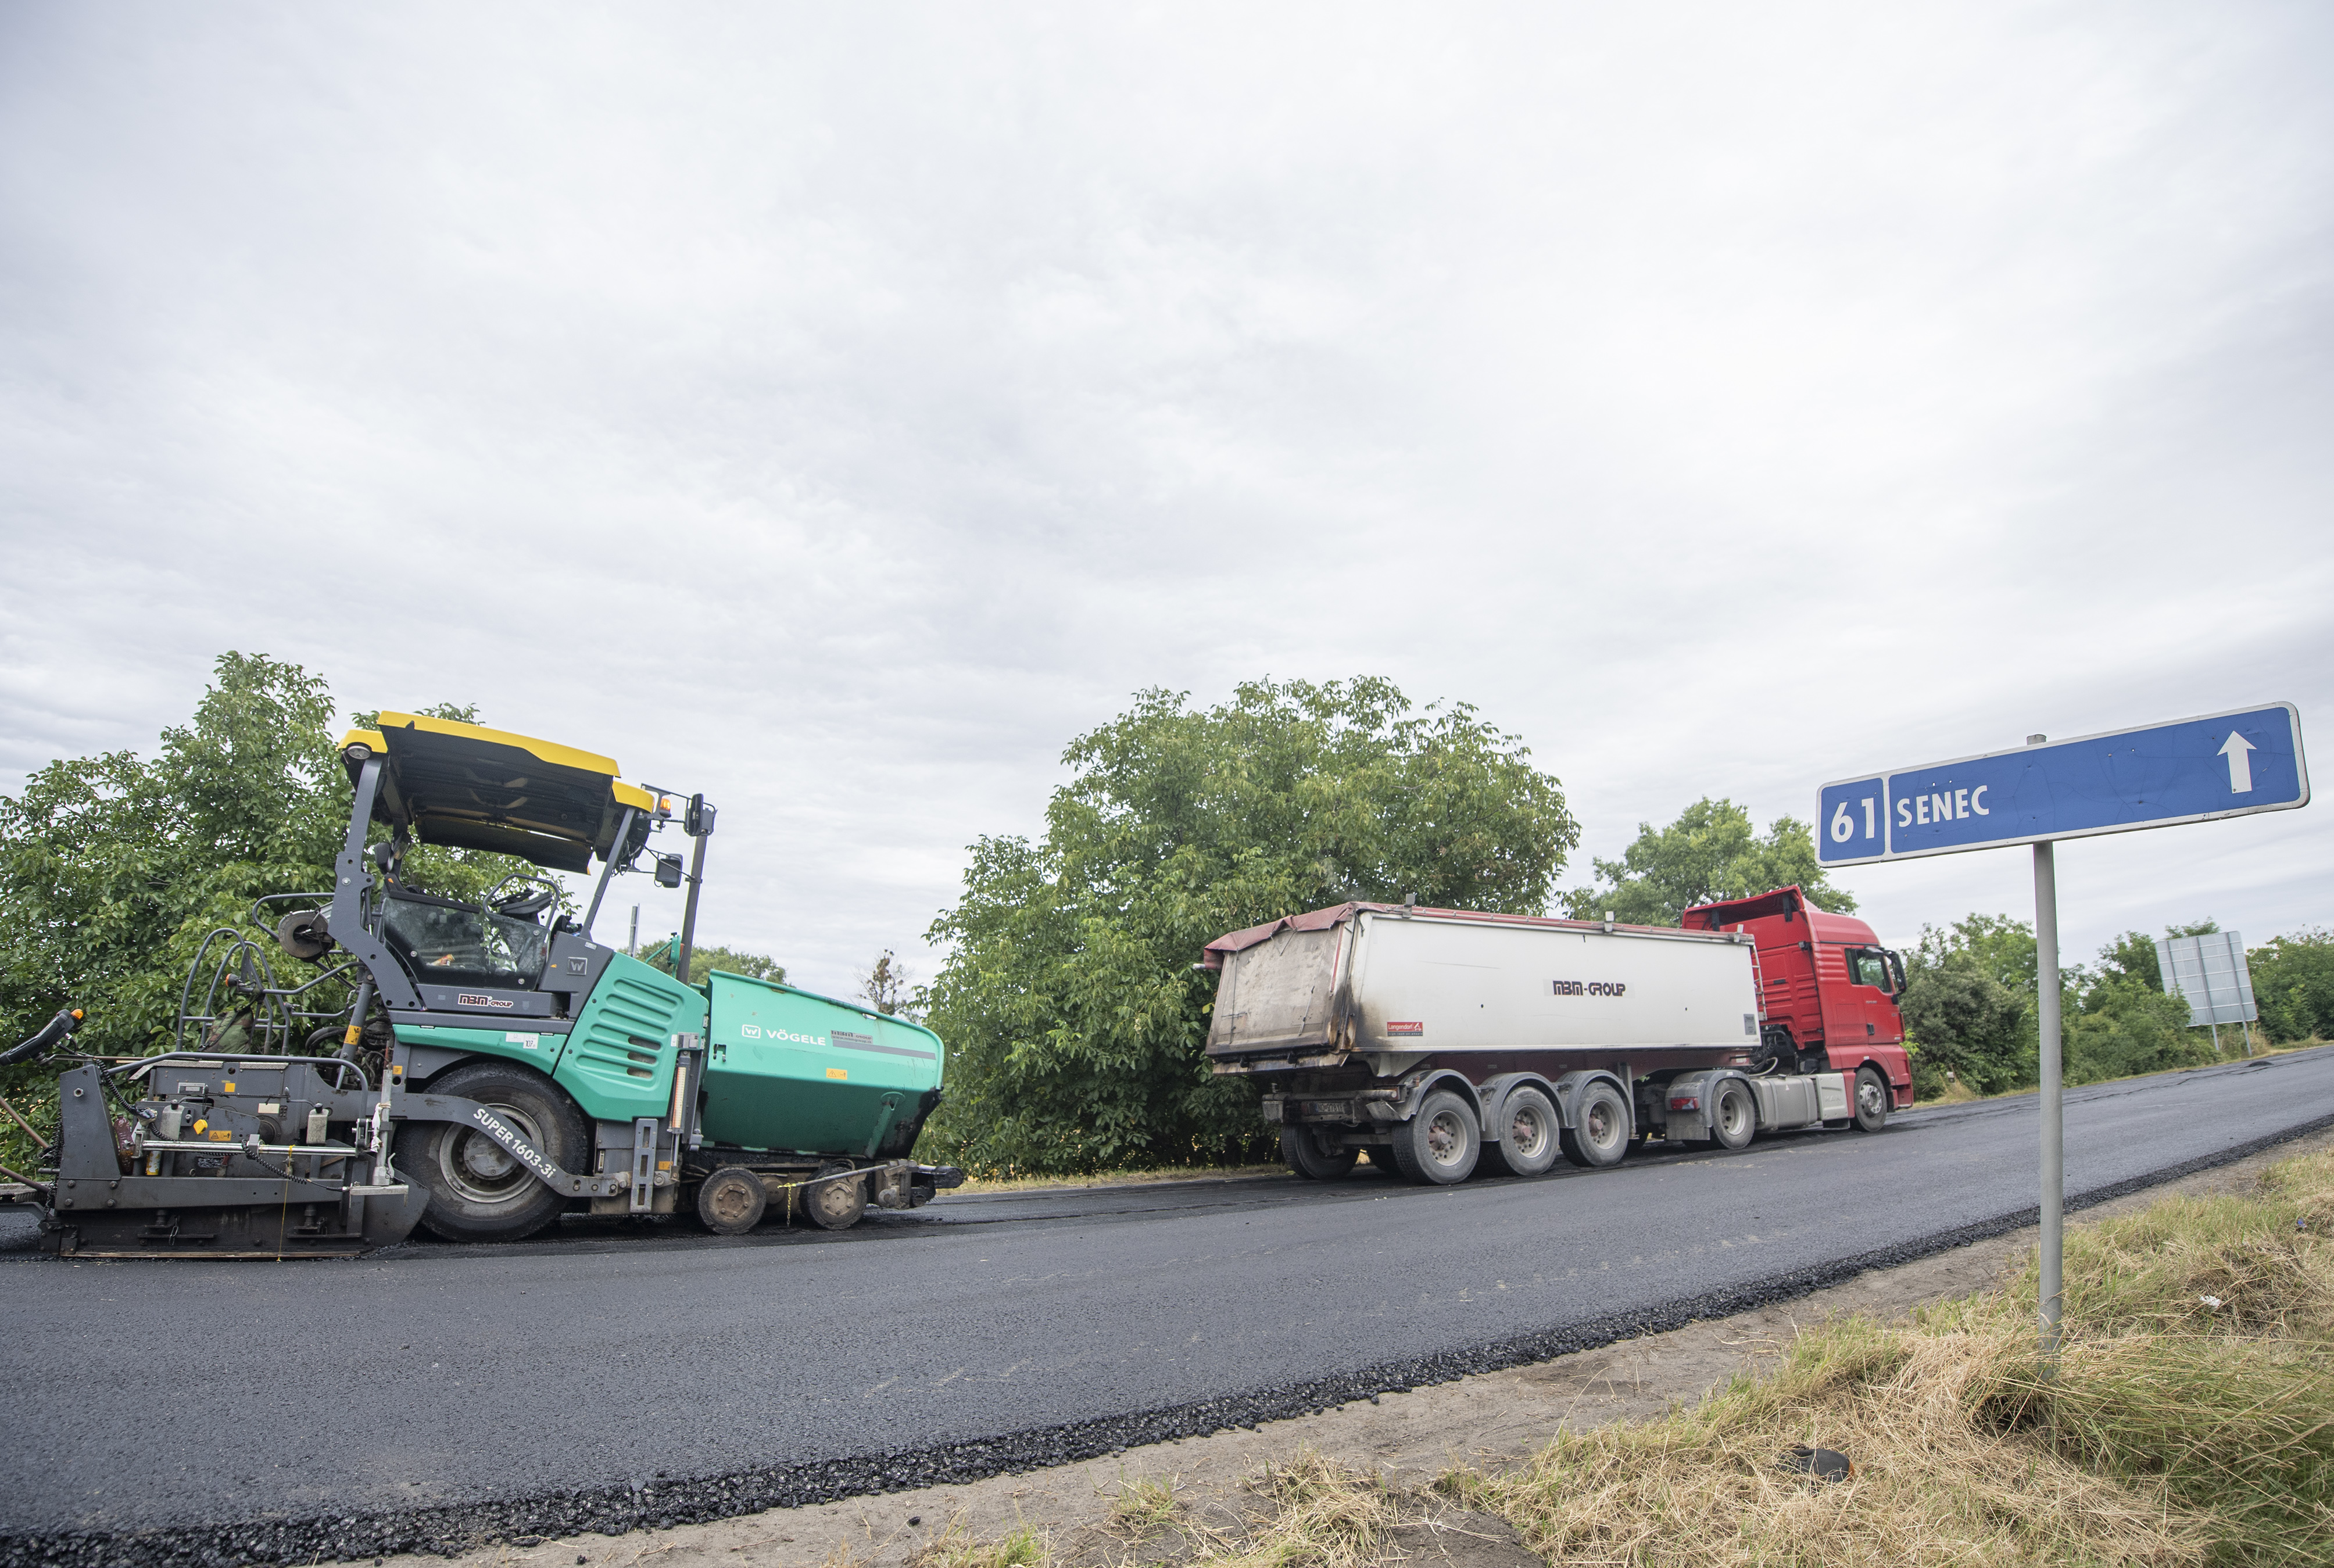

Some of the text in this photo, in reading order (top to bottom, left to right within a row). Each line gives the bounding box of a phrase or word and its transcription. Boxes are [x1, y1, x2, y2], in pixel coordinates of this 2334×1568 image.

[1831, 785, 1990, 843] 61 SENEC
[570, 961, 585, 972] W
[766, 1029, 826, 1046] VÖGELE
[473, 1108, 556, 1179] SUPER 1603-3i
